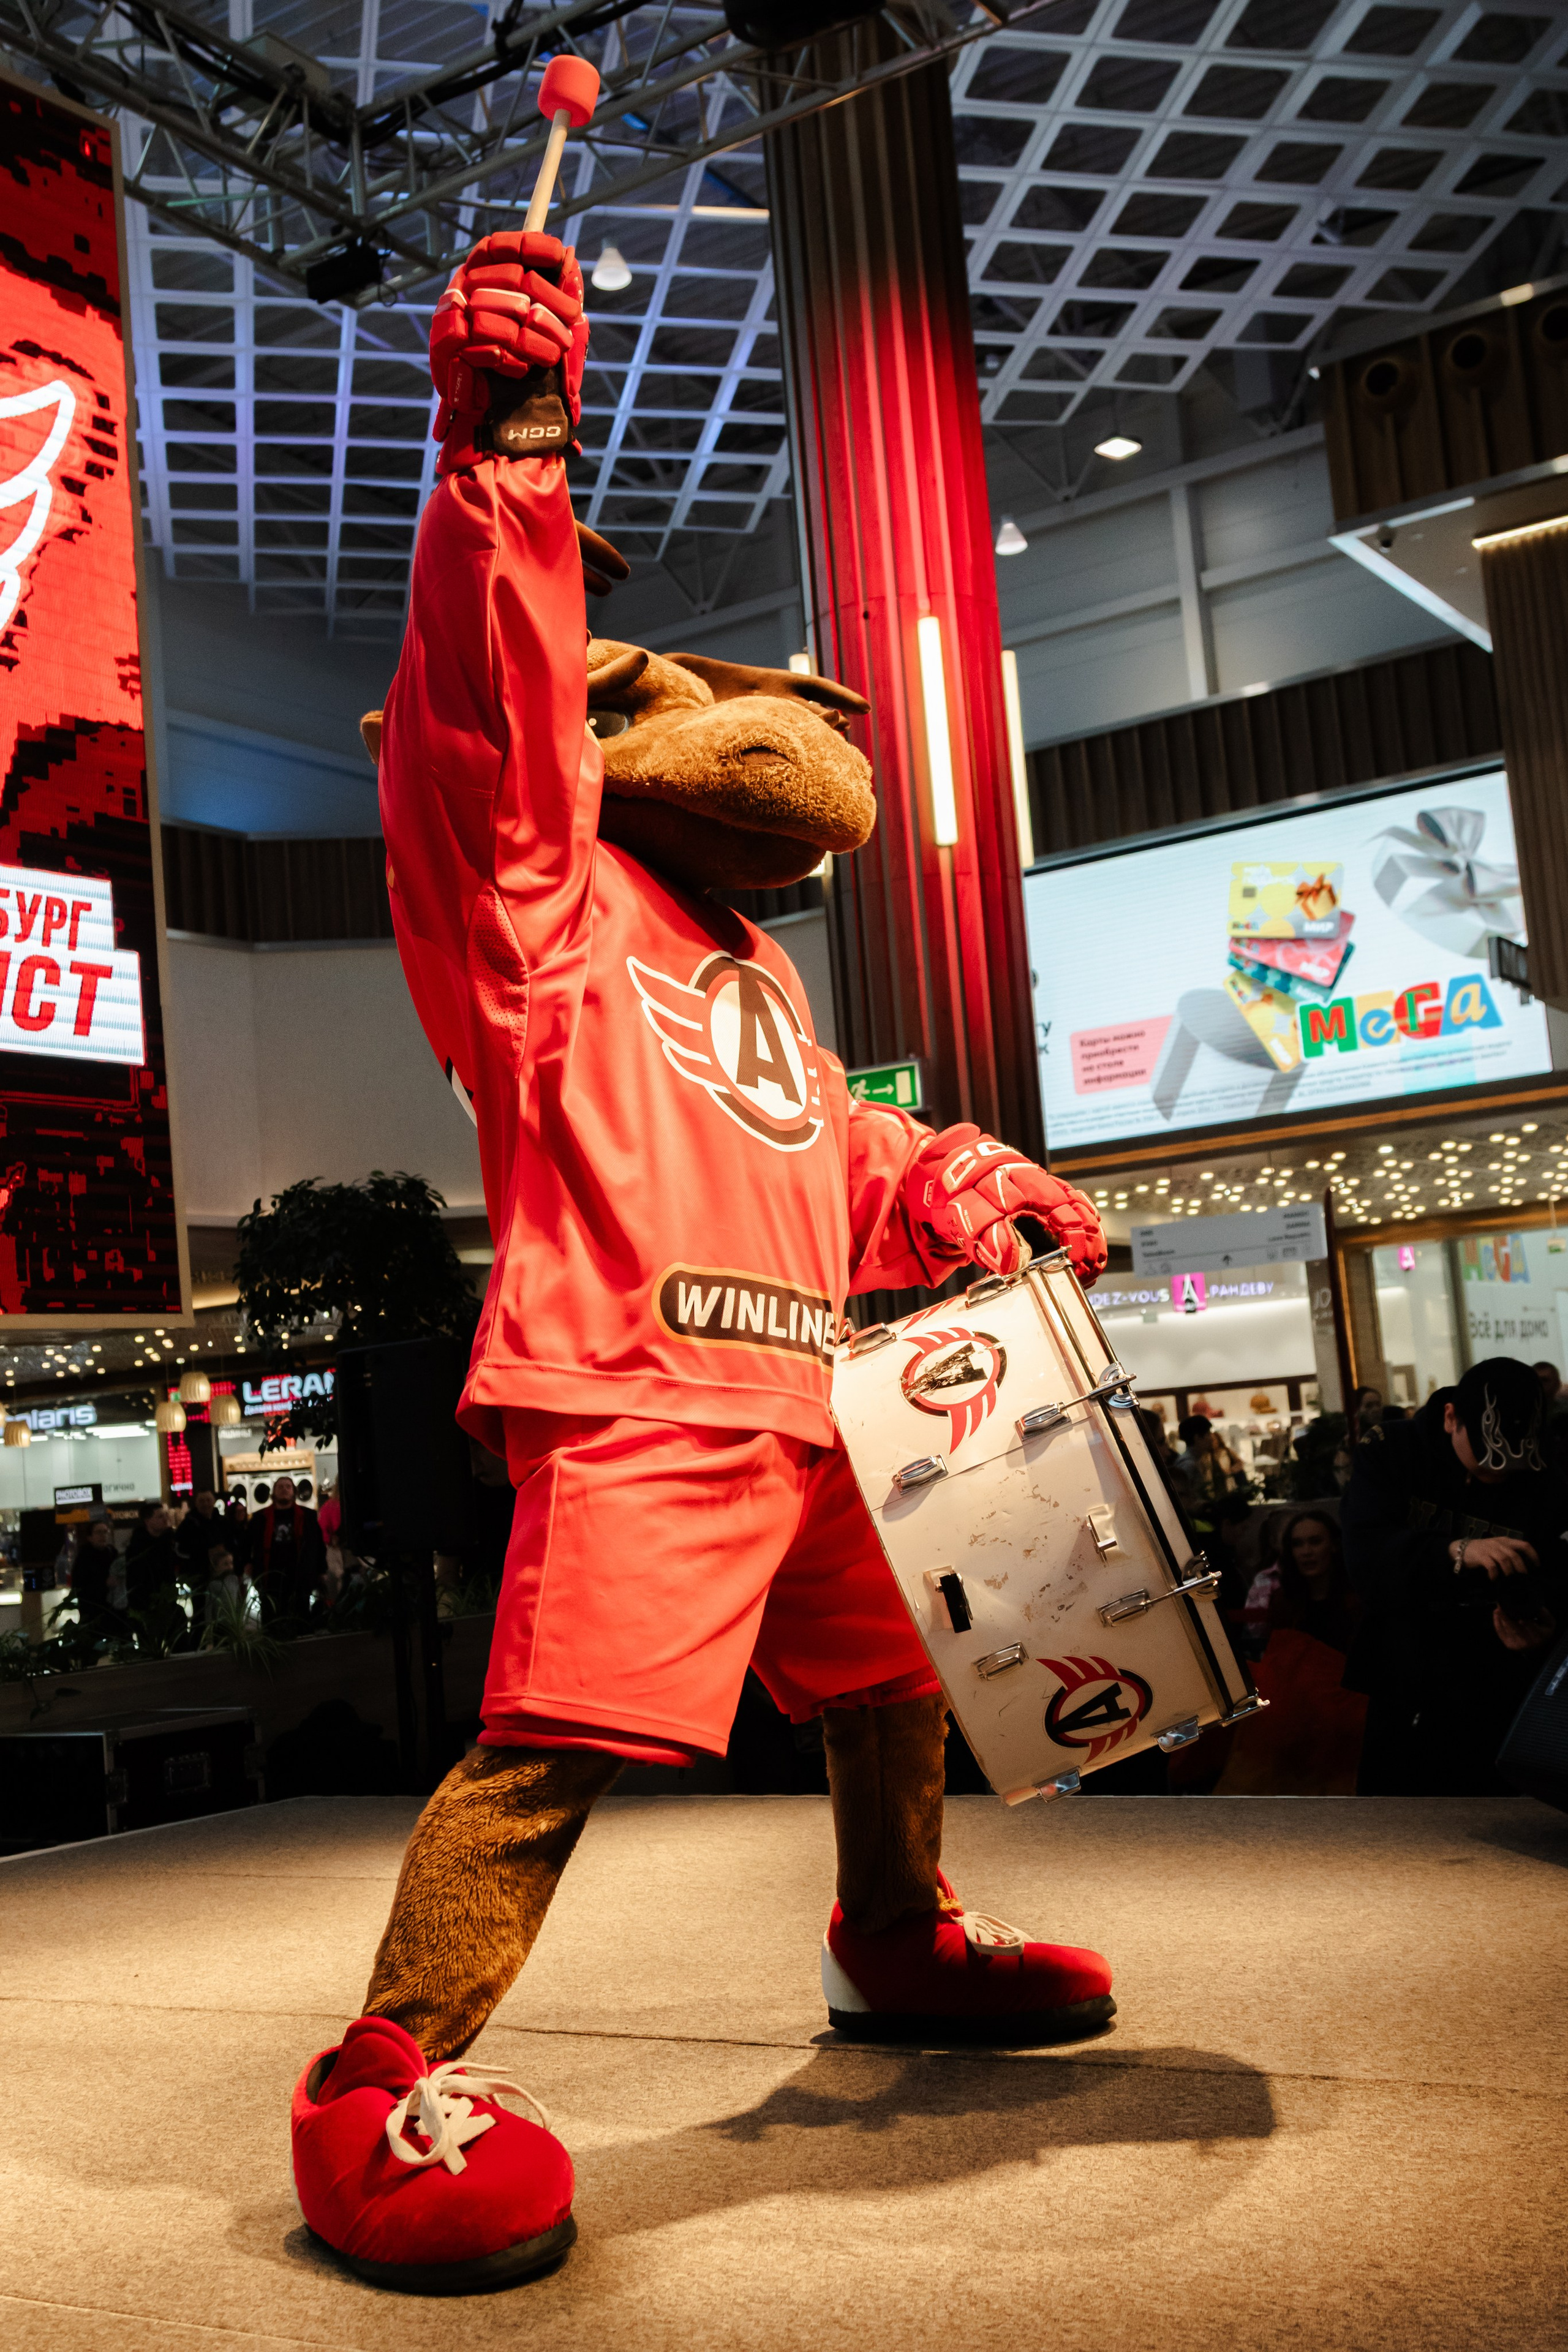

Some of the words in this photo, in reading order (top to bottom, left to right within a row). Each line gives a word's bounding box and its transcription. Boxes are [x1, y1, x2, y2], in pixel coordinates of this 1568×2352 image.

[508, 426, 561, 440] CCM
[1209, 1281, 1275, 1298] РАНДЕВУ
[677, 1281, 835, 1355] WINLINE
[0, 1404, 97, 1436] laris
